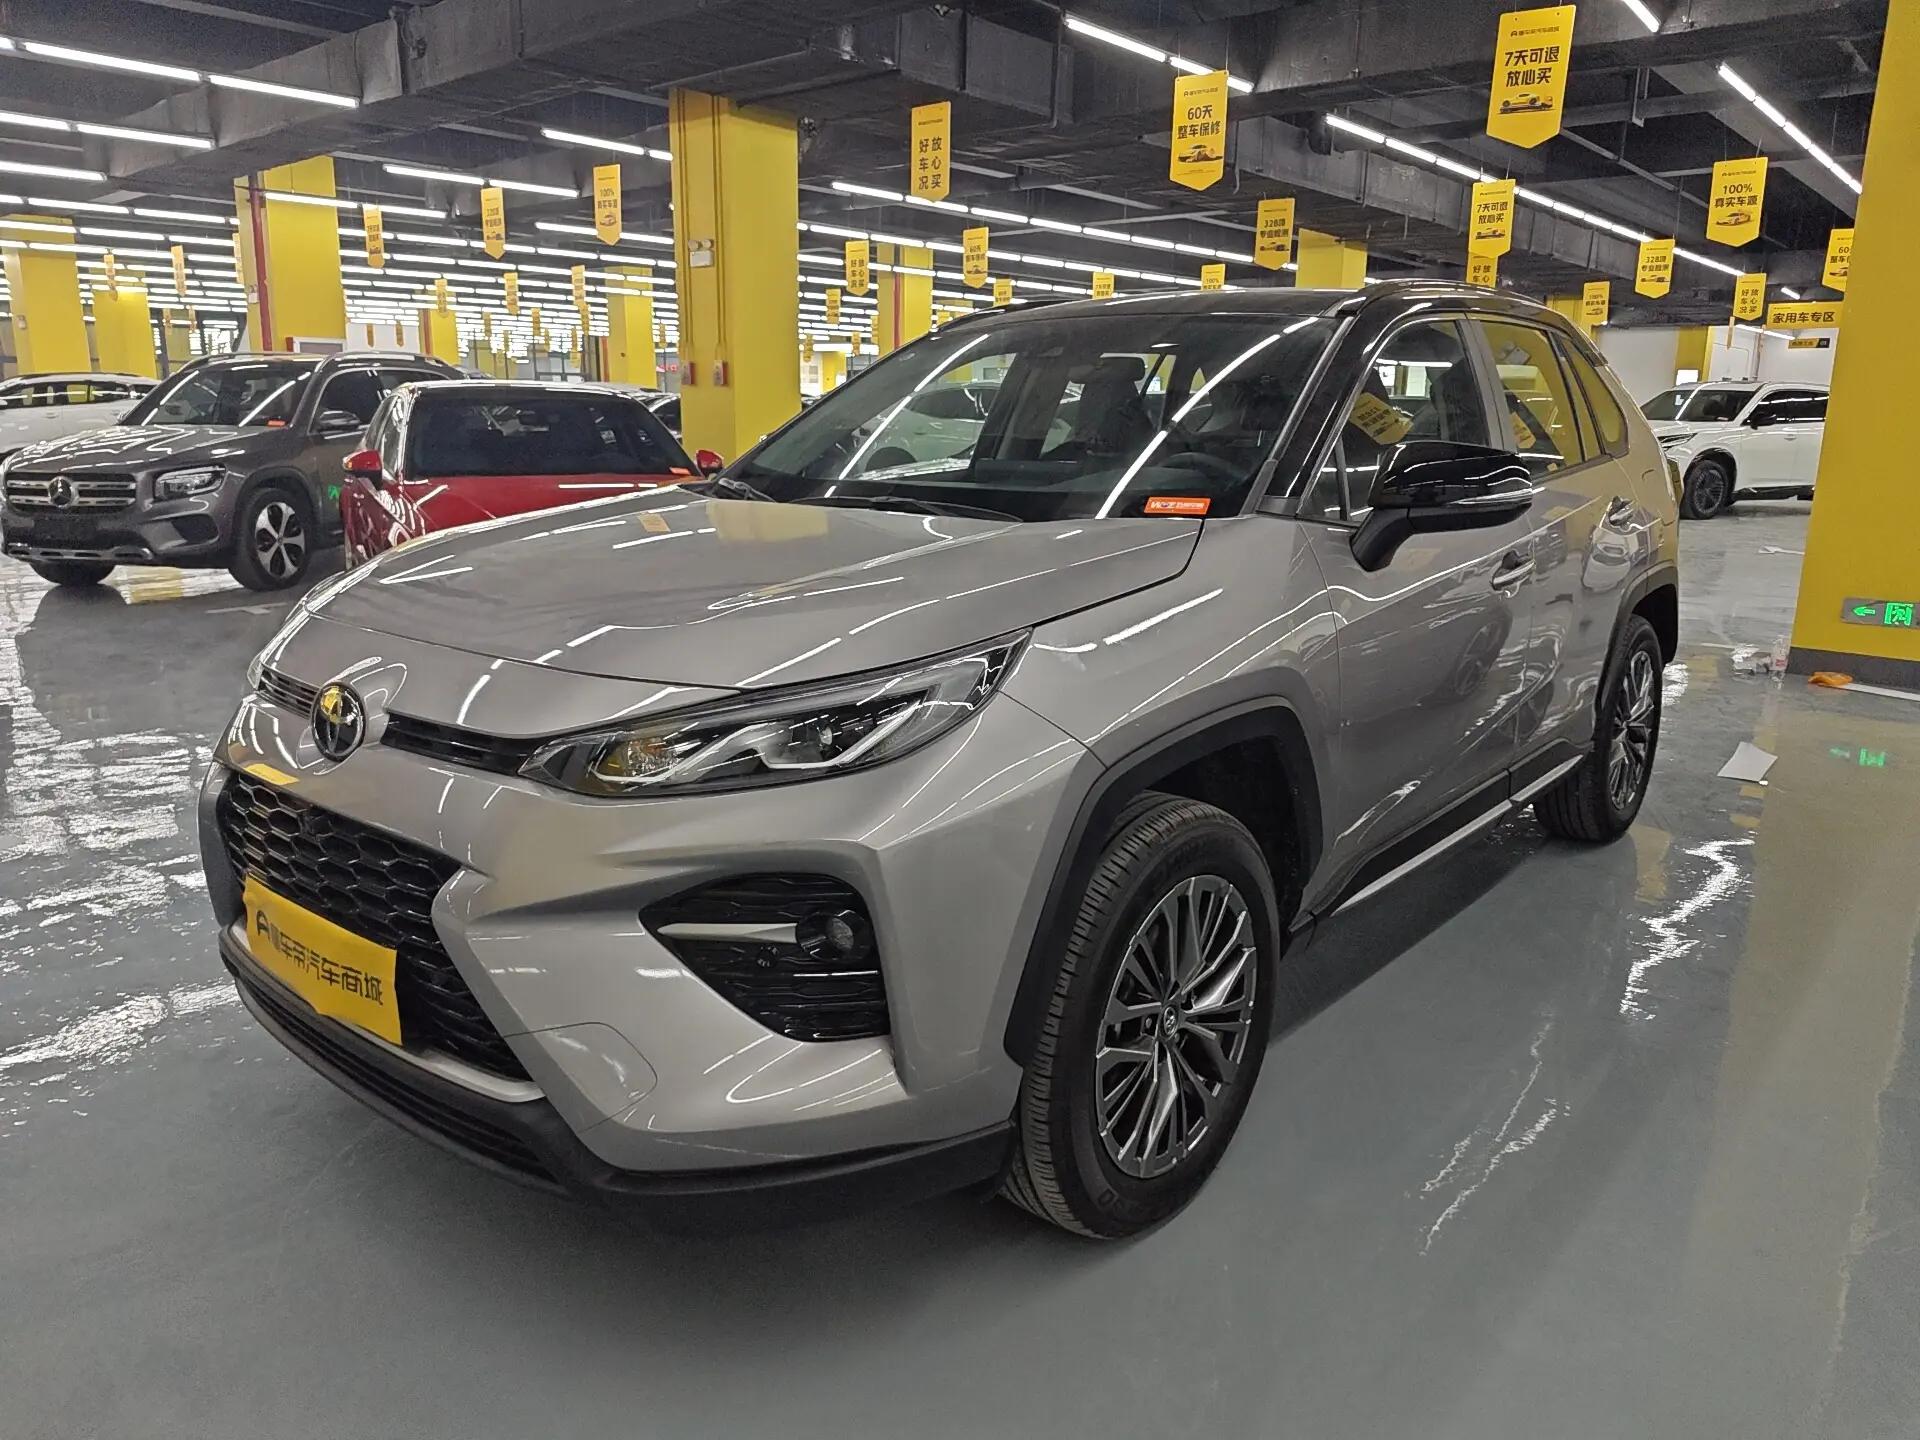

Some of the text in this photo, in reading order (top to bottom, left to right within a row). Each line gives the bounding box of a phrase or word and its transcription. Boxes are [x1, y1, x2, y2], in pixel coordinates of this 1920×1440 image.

[1504, 45, 1560, 67] 7天可退
[1506, 67, 1552, 87] 放心买
[1187, 104, 1213, 121] 60天
[1177, 121, 1221, 140] 整车保修
[918, 138, 929, 190] 好车况
[931, 136, 942, 190] 放心买
[1722, 183, 1753, 195] 100%
[1476, 202, 1508, 213] 7天可退
[1838, 246, 1852, 254] 60
[1772, 311, 1835, 324] 家用车专区
[270, 922, 384, 1006] 车帝汽车商城
